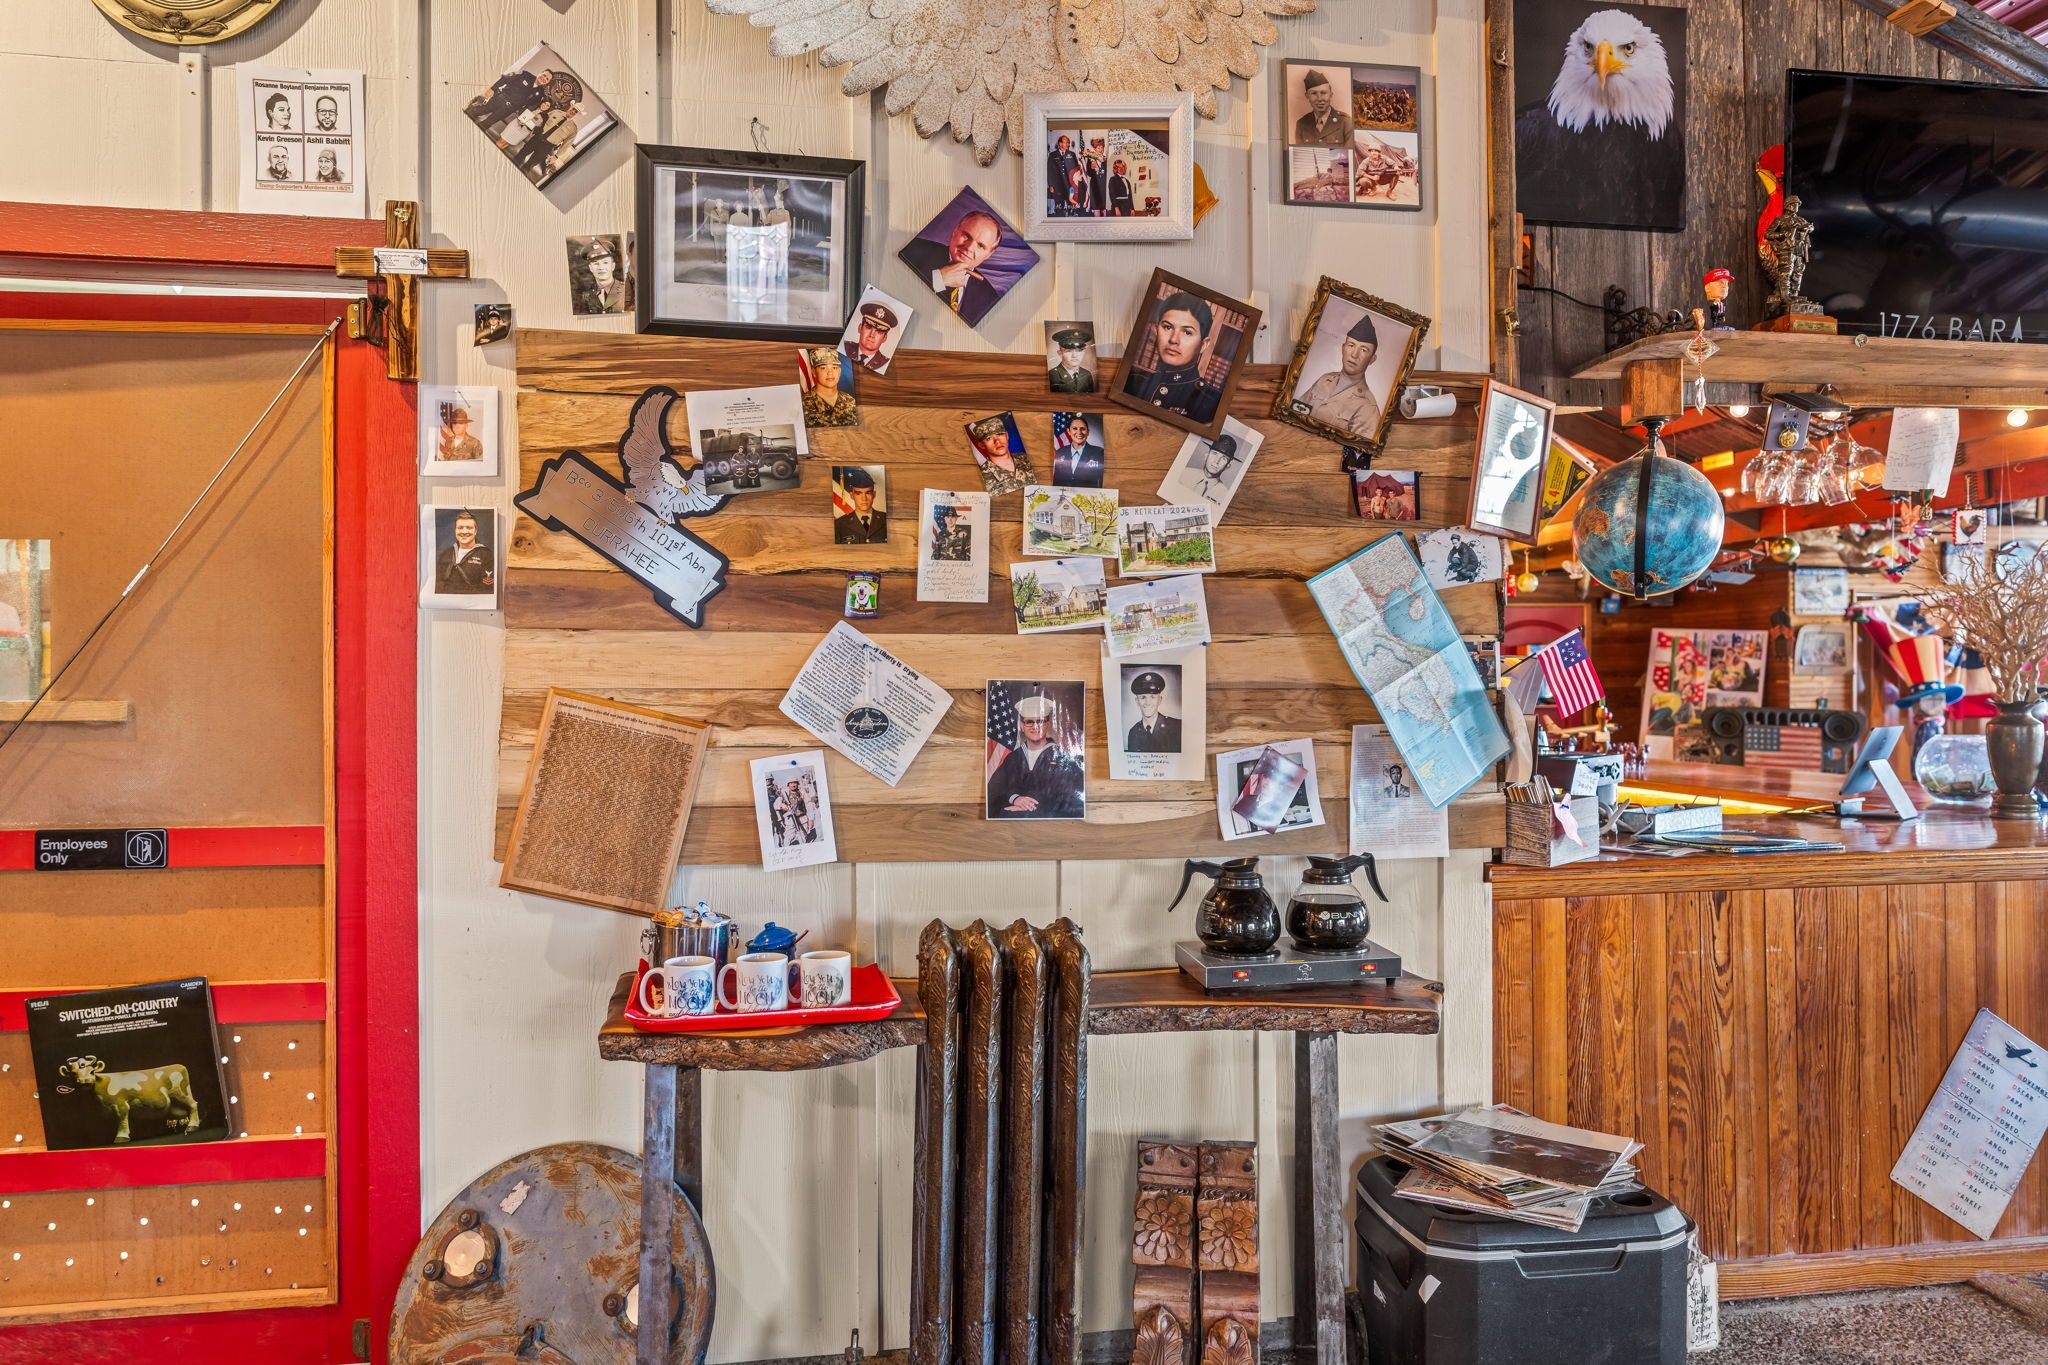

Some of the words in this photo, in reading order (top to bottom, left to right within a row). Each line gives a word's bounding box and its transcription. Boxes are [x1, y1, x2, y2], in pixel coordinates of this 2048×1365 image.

[1880, 312, 1935, 339] 1776
[1948, 317, 2006, 342] BAR
[582, 517, 660, 575] CURRAHEE
[648, 528, 687, 552] 101st
[682, 551, 706, 574] Abn
[878, 649, 897, 665] Liberty
[40, 839, 108, 851] Employees
[40, 852, 69, 865] Only
[31, 1000, 49, 1008] RCA
[59, 997, 178, 1022] SWITCHED-ON-COUNTRY
[1978, 1046, 2000, 1065] ALPHA
[1972, 1056, 1995, 1075] BRAVO
[1961, 1077, 1981, 1095] DELTA
[1968, 1068, 1995, 1090] CHARLIE
[2017, 1073, 2048, 1098] NOVEMBE
[2006, 1094, 2023, 1108] PAPA
[2012, 1084, 2034, 1101] OSCAR
[1943, 1110, 1962, 1125] GOLF
[1950, 1099, 1981, 1122] FOXTROT
[2000, 1105, 2027, 1126] QUEBEC
[1938, 1120, 1959, 1139] HOTEL
[1995, 1115, 2019, 1134] ROMEO
[1989, 1124, 2014, 1145] SIERRA
[1985, 1137, 2007, 1155] TANGO
[1920, 1154, 1937, 1166] KILO
[1973, 1158, 1998, 1177] VICTOR
[1978, 1147, 2010, 1171] UNIFORM
[1909, 1175, 1927, 1189] MIKE
[1962, 1181, 1982, 1196] X-RAY
[1967, 1169, 1998, 1192] WHISKEY
[1950, 1202, 1968, 1216] ZULU
[1956, 1192, 1983, 1211] YANKEE
